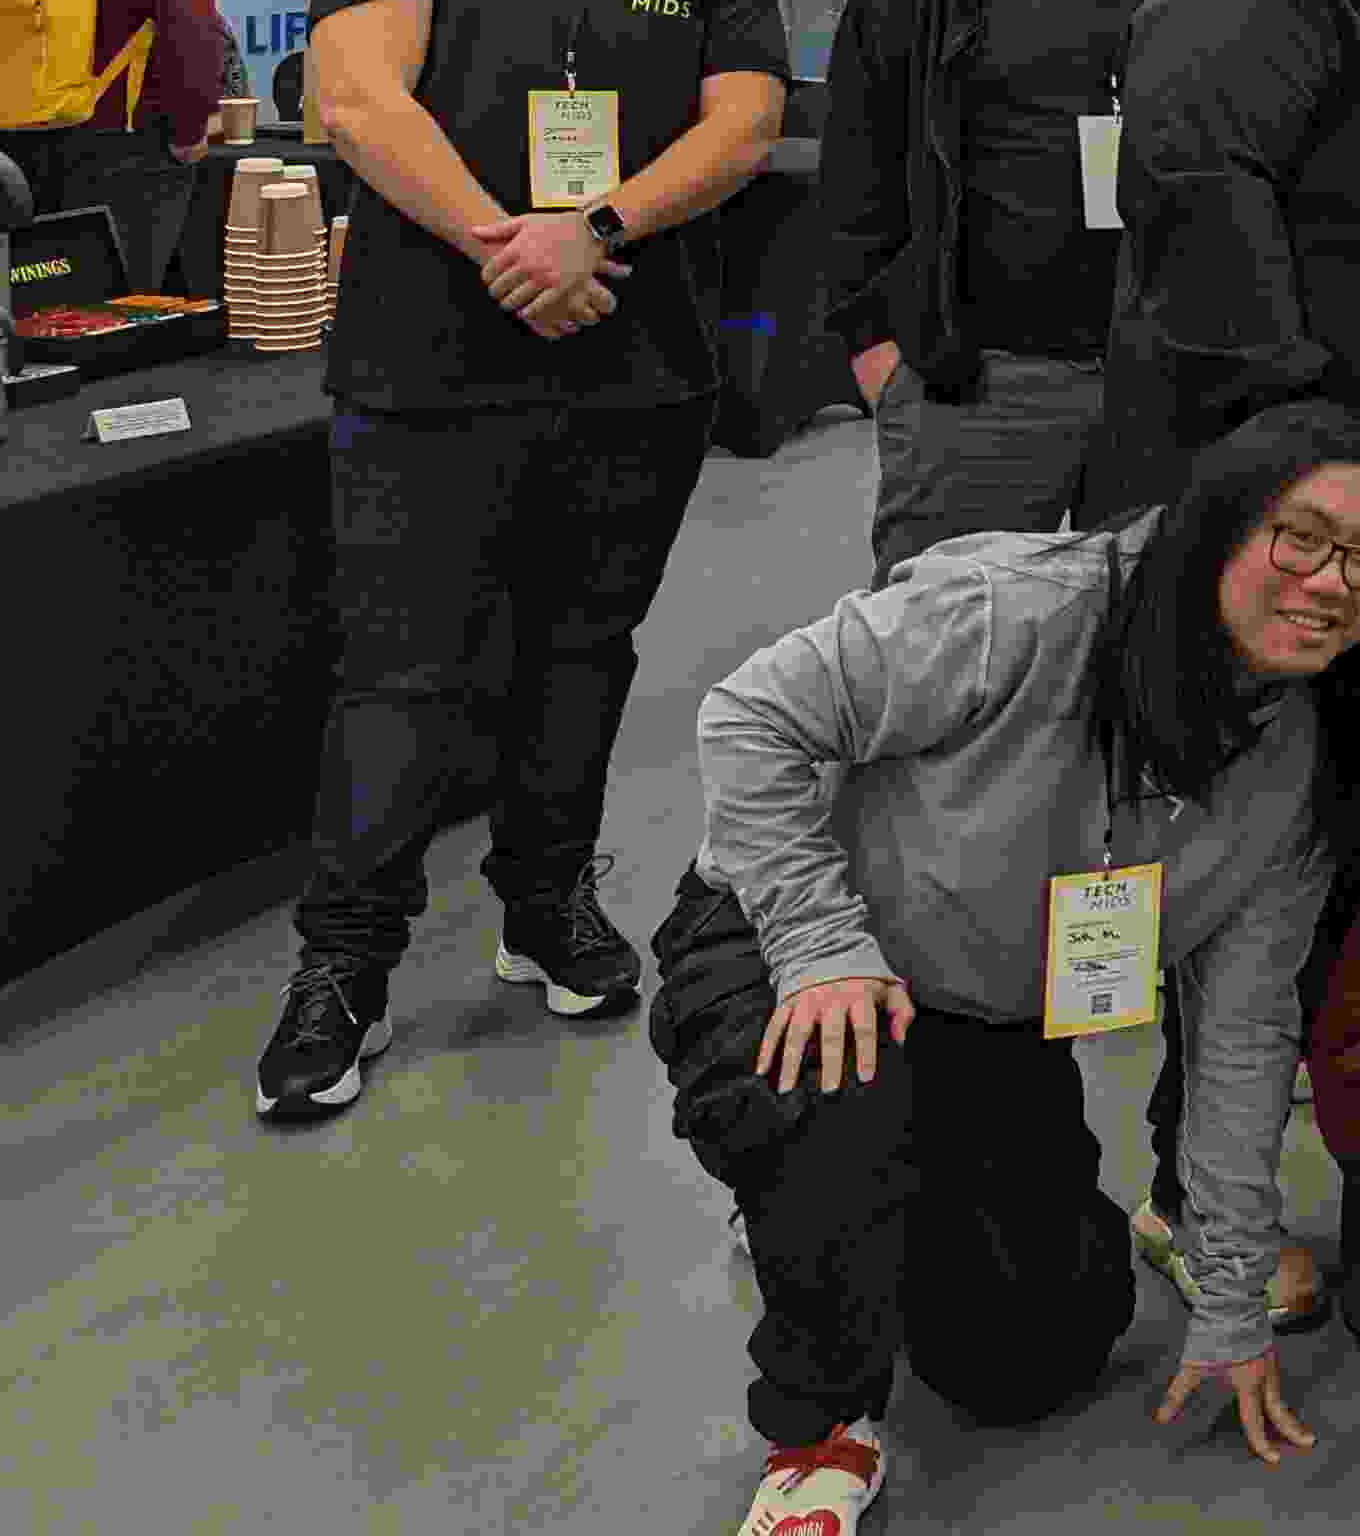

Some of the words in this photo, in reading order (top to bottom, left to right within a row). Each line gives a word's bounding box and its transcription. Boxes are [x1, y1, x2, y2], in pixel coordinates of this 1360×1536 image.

[246, 12, 306, 55] LIF
[9, 257, 72, 283] WININGS
[1084, 881, 1128, 898] TECH
